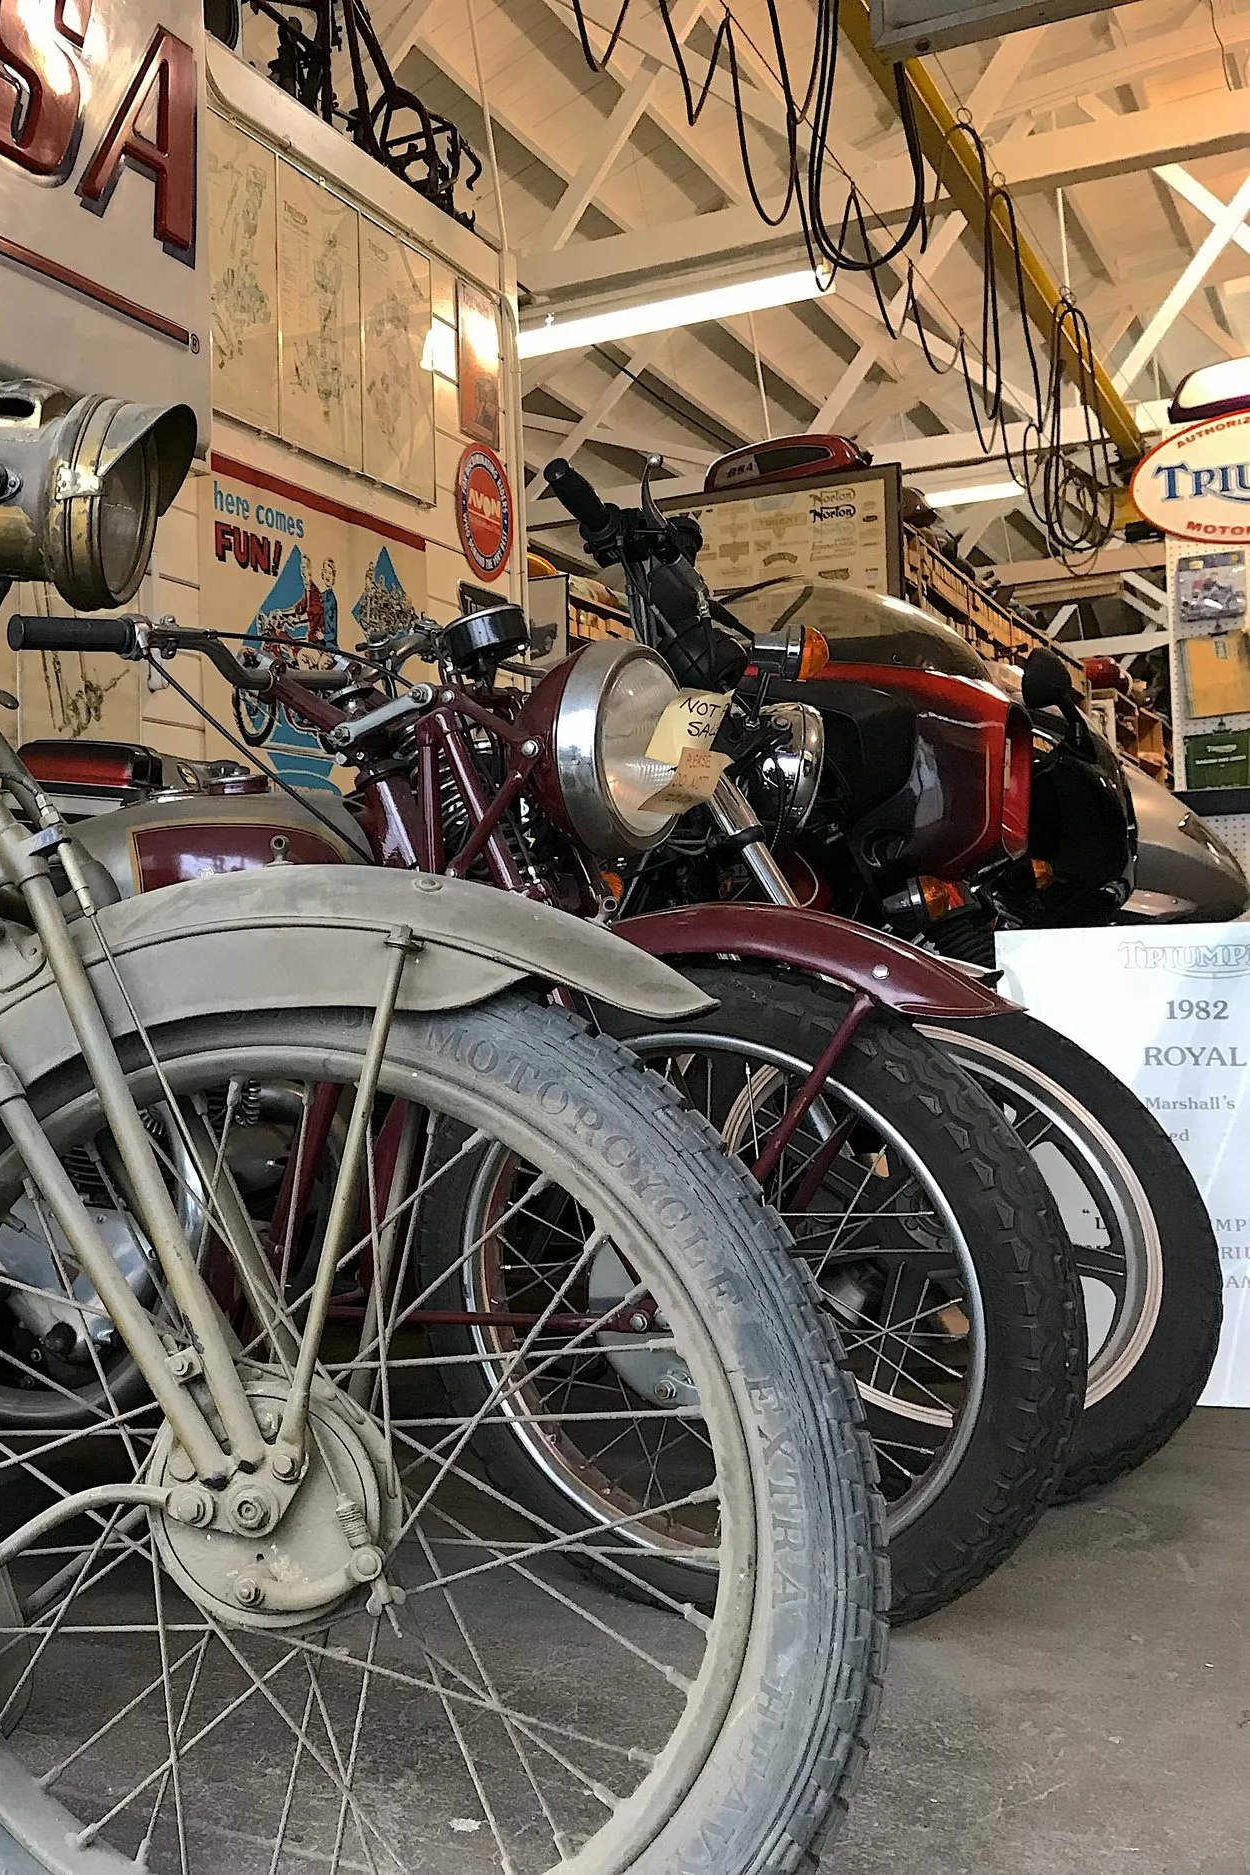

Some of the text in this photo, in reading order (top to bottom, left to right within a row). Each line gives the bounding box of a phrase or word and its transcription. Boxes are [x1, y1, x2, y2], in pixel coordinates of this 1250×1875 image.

[726, 461, 754, 478] BSA
[468, 487, 501, 519] AVON
[496, 478, 508, 514] RIDERS
[809, 488, 856, 507] Norton
[213, 480, 305, 539] here comes
[809, 504, 856, 523] Norton
[462, 512, 471, 538] WHO
[1186, 521, 1250, 535] MOTO
[214, 520, 283, 577] FUN!
[679, 697, 721, 718] NOT
[687, 721, 716, 738] SAL
[1166, 1000, 1229, 1020] 1982
[1144, 1046, 1248, 1067] ROYAL
[1144, 1095, 1236, 1111] Marshall's
[424, 1021, 744, 1312] MOTORCYCLE
[744, 1375, 808, 1609] EXTRA
